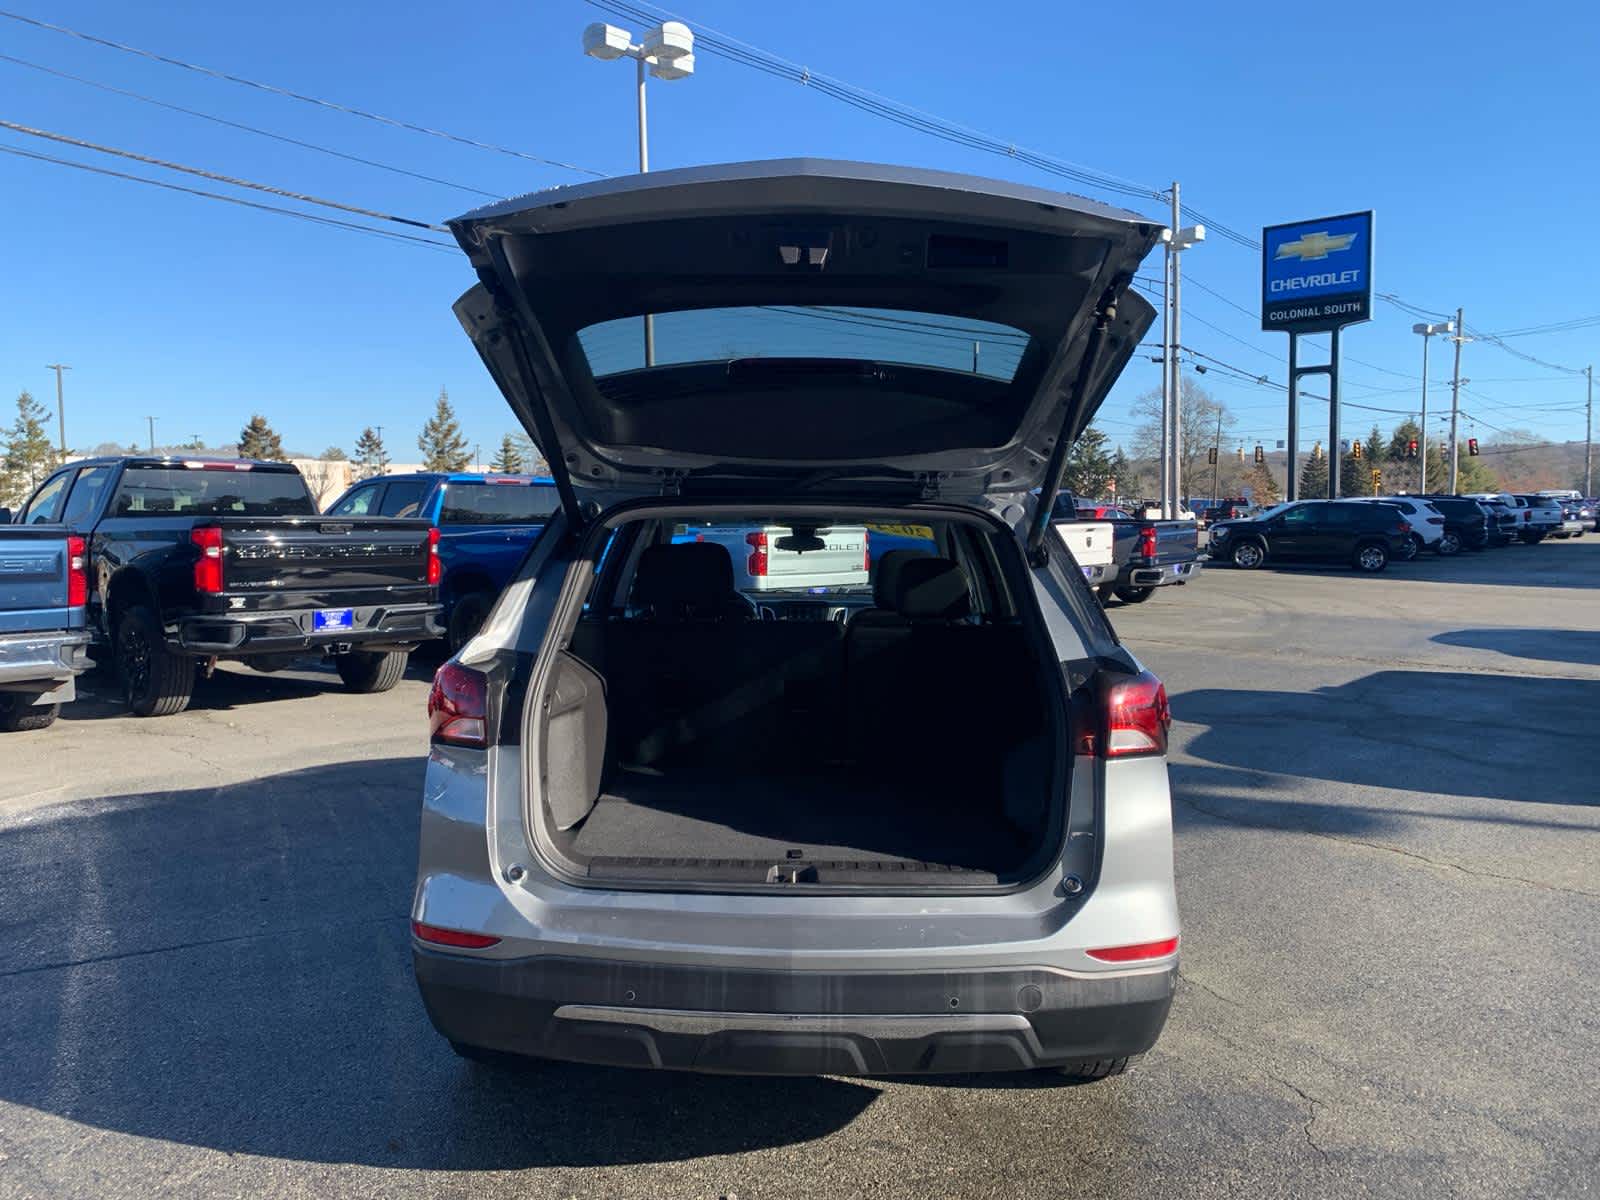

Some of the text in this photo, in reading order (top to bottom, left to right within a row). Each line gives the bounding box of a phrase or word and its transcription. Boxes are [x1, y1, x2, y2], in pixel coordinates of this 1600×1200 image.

[1271, 270, 1361, 292] CHEVROLET
[1270, 302, 1361, 321] COLONIAL SOUTH
